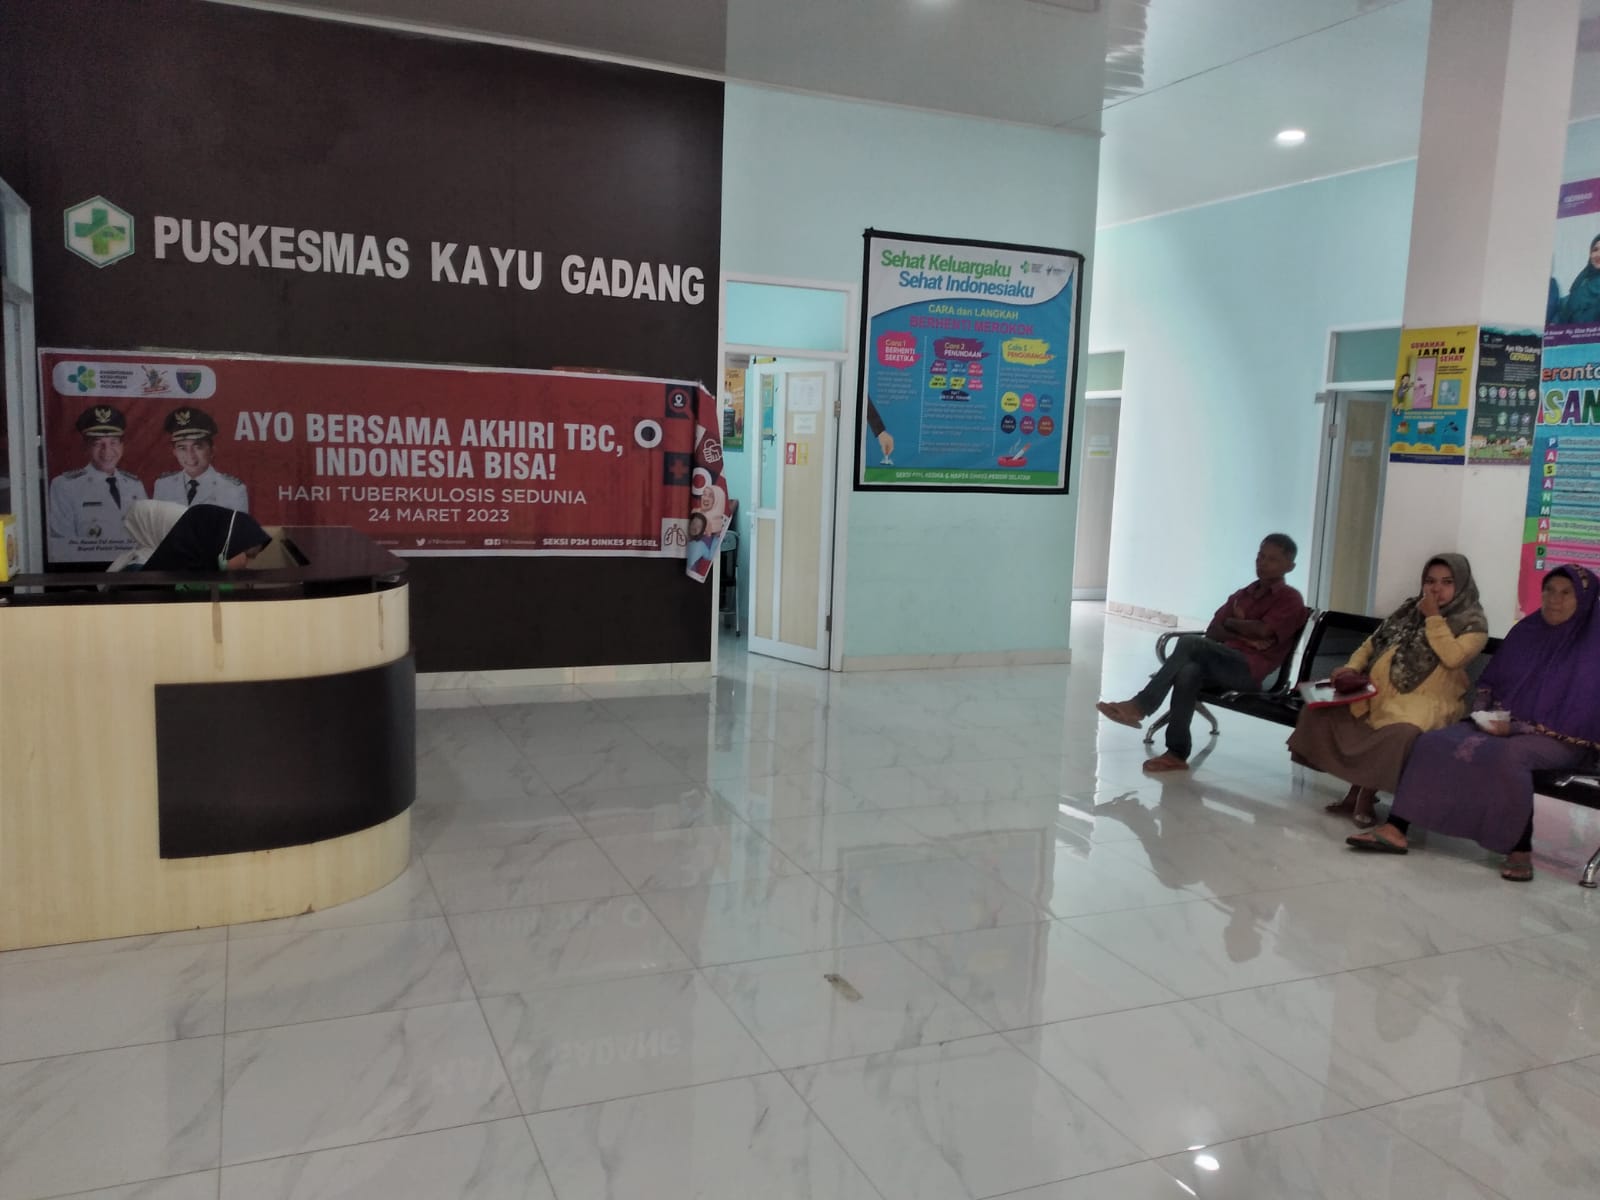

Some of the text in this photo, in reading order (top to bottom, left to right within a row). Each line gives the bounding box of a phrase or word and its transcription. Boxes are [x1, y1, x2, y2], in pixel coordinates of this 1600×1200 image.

[154, 215, 705, 305] PUSKESMAS KAYU GADANG
[881, 250, 925, 271] Sehat
[928, 254, 1012, 279] Keluargaku
[899, 271, 1035, 298] Sehat Indonesiaku
[928, 304, 1019, 320] CARA dan LANGKAH
[910, 315, 1034, 336] BERHENTI MEROKOK
[885, 354, 915, 362] SEKETIKA
[234, 411, 623, 457] AYO BERSAMA AKHIRI TBC,
[315, 447, 556, 480] INDONESIA BISA!
[278, 485, 587, 505] HARI TUBERKULOSIS SEDUNIA
[368, 508, 509, 522] 24 MARET 2023
[543, 538, 568, 546] SEKSI
[570, 538, 589, 546] P2M
[591, 538, 624, 547] DINKES
[626, 539, 658, 548] PESSEL
